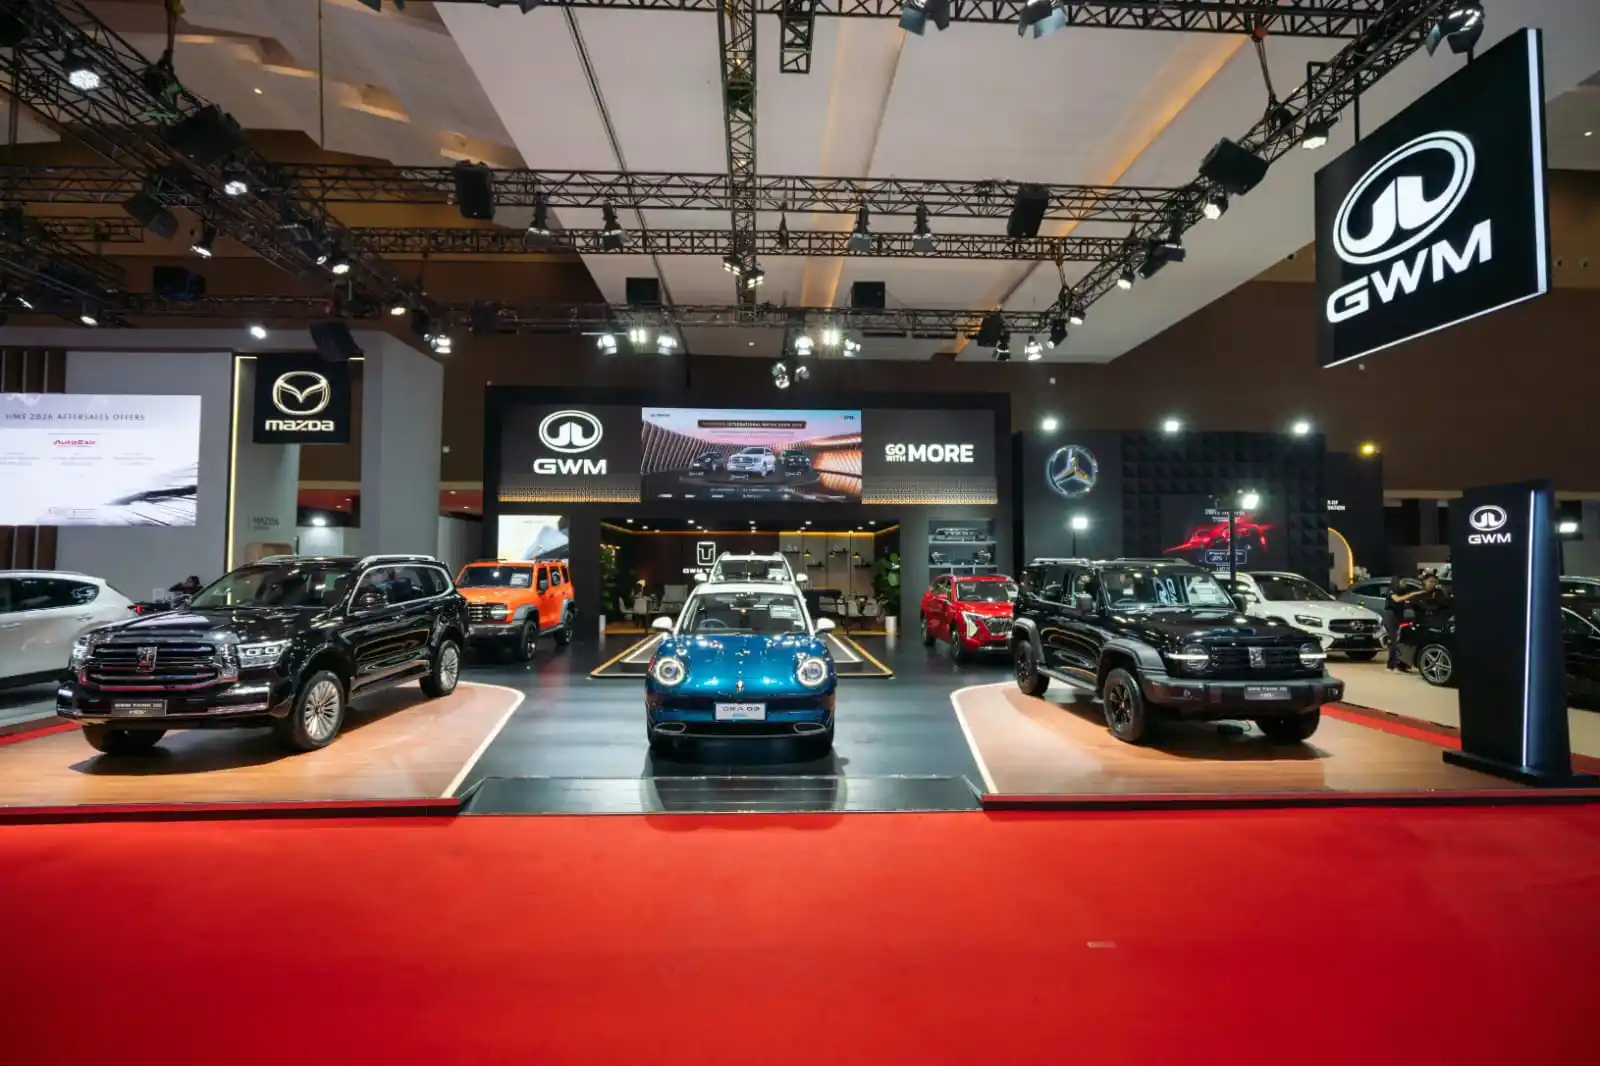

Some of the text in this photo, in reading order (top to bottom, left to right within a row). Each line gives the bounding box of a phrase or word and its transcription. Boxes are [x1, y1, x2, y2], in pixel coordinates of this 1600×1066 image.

[1326, 218, 1493, 324] GWM
[112, 412, 146, 421] OFFERS
[885, 443, 906, 456] GO
[907, 443, 975, 462] MORE
[885, 454, 906, 462] WITH
[533, 458, 608, 476] GWM
[1468, 532, 1512, 544] GWM
